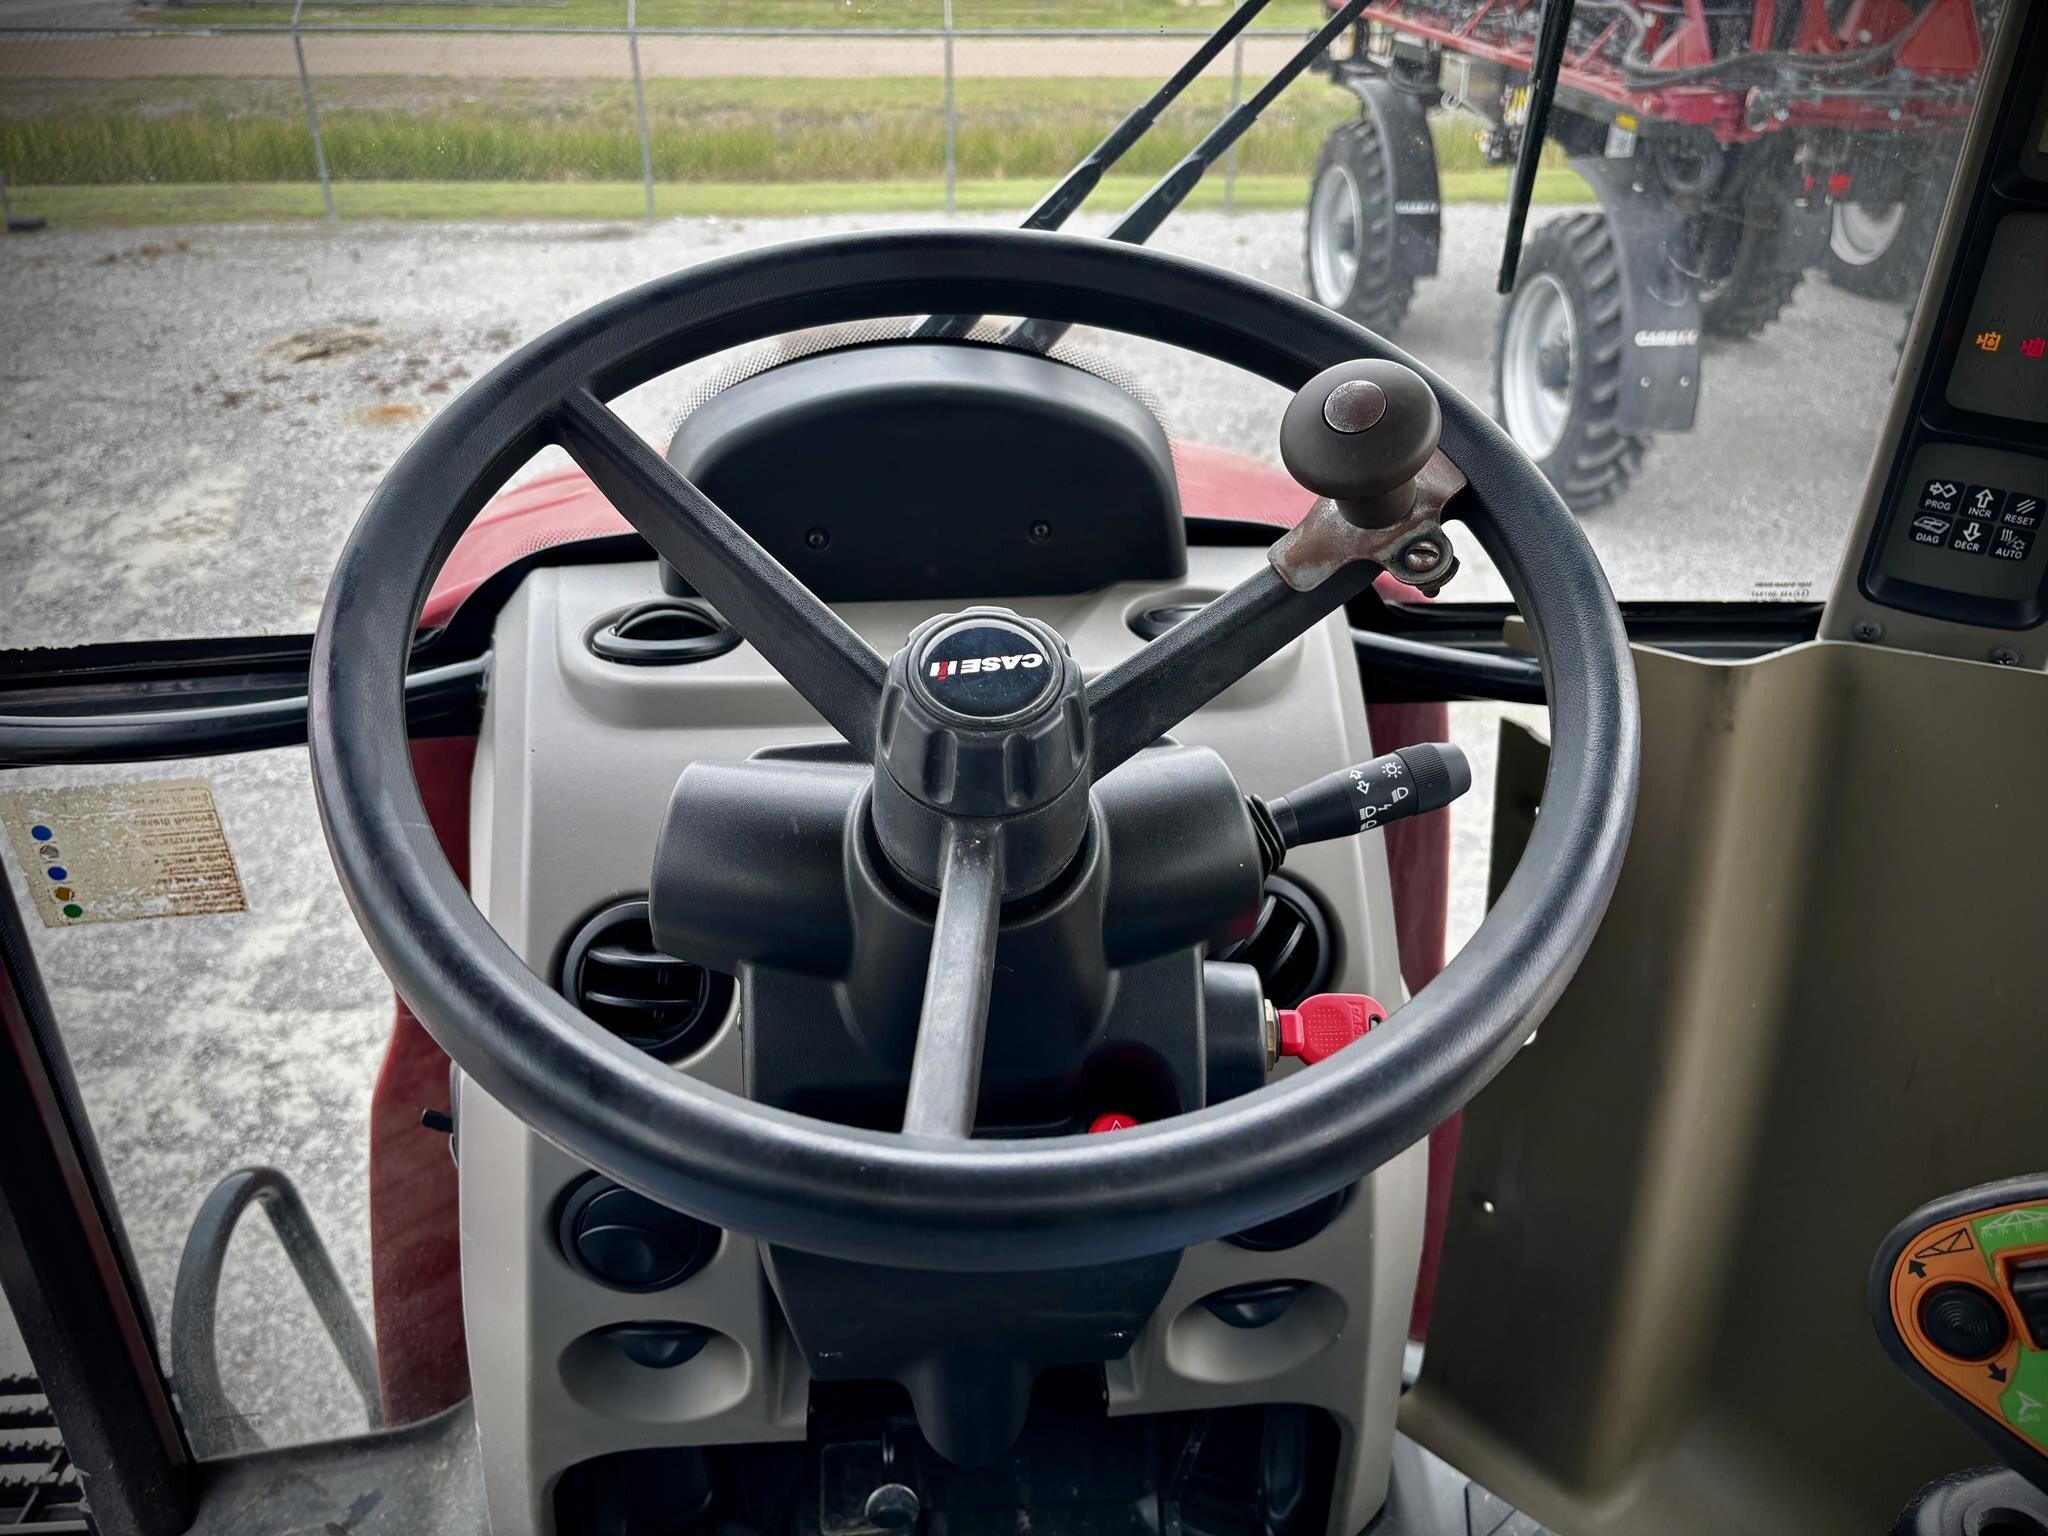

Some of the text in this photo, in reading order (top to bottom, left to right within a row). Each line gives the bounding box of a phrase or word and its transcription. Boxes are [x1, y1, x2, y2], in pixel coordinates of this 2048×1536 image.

[1924, 498, 1951, 511] PROG
[1967, 506, 1992, 518] INCR
[2004, 513, 2036, 526] RESET
[1915, 532, 1940, 544] DIAG
[1953, 539, 1980, 552] DECR
[1995, 547, 2023, 560] AUTO
[960, 653, 1044, 675] CASE
